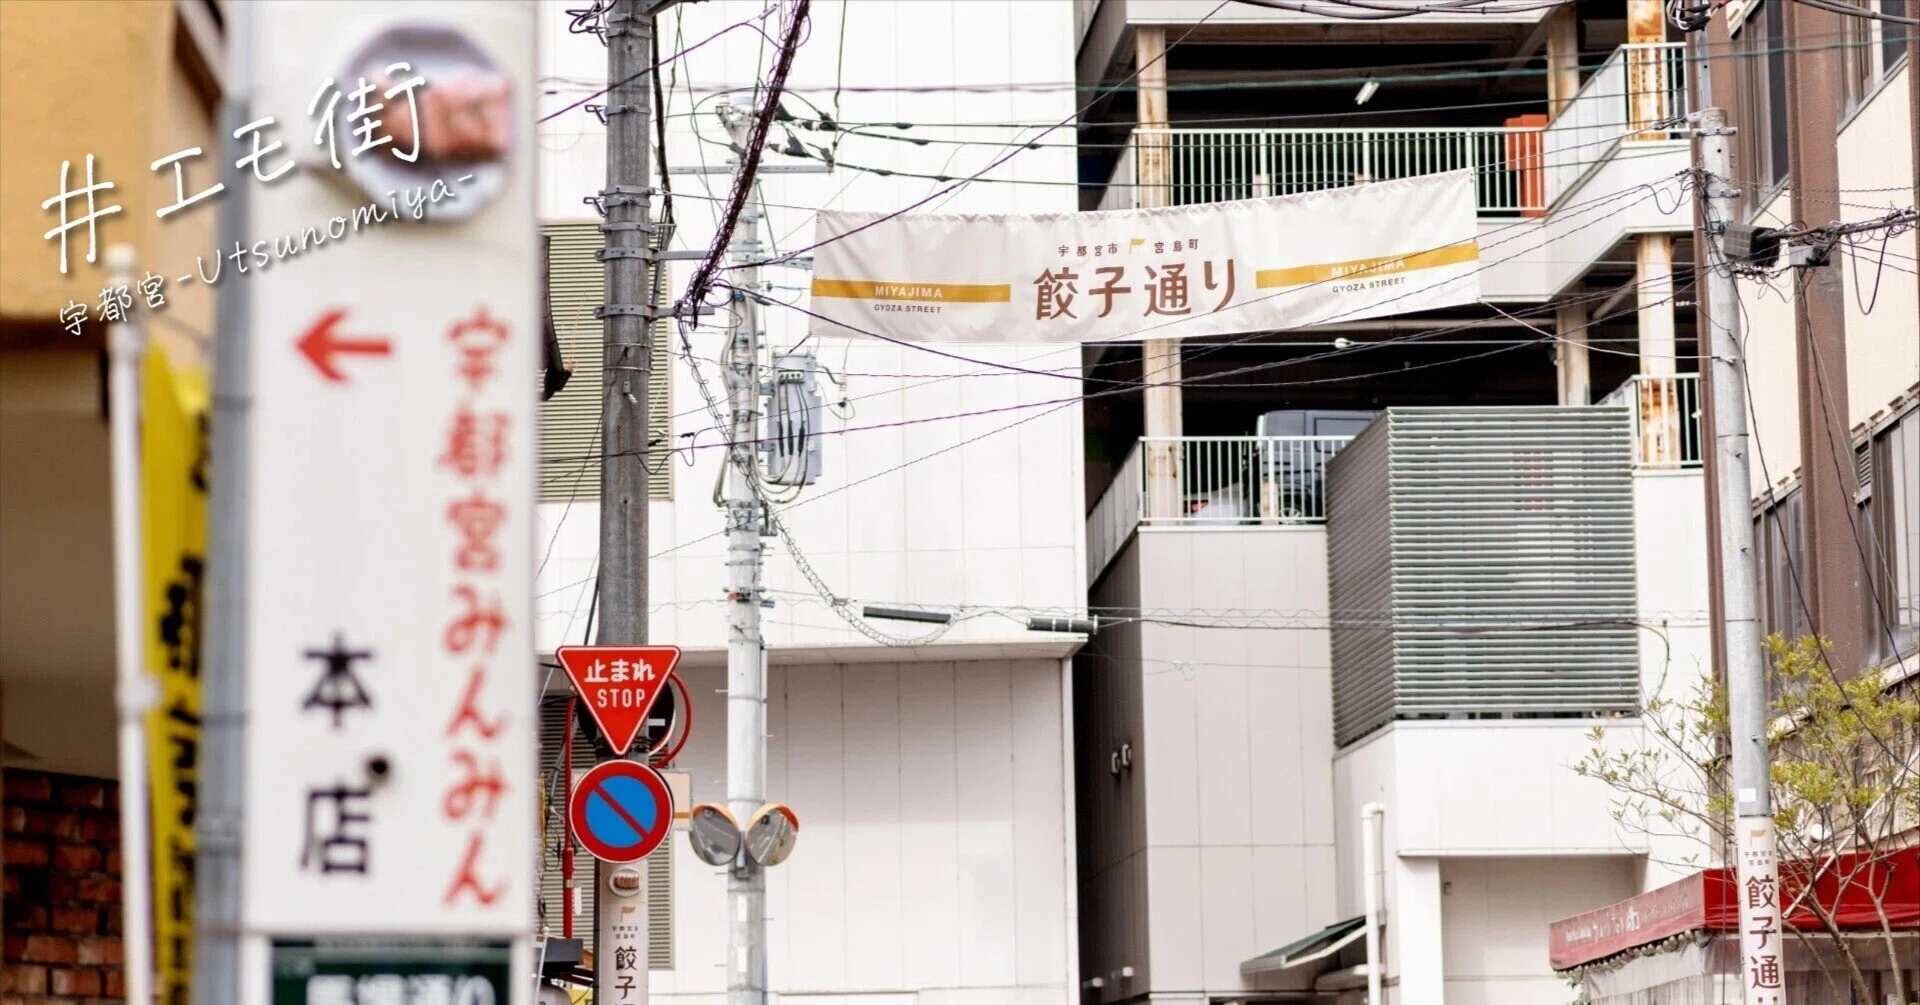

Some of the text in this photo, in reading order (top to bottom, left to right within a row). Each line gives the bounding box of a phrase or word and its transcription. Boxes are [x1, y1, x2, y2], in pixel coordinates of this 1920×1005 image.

[1058, 238, 1199, 257] 宇都宮市 宮島町
[1330, 259, 1405, 278] MIYAJIMA
[875, 285, 942, 298] MIYAJIMA
[1033, 258, 1235, 321] 餃子通り
[1332, 276, 1406, 293] GYOZA STREET
[874, 304, 941, 313] GYOZA STREET
[438, 305, 509, 910] 宇都宮みんみん
[584, 658, 656, 682] 止まれ
[597, 688, 645, 708] STOP
[301, 633, 376, 876] 本店
[1745, 874, 1781, 1004] 餃子通
[614, 945, 638, 1005] 餃子
